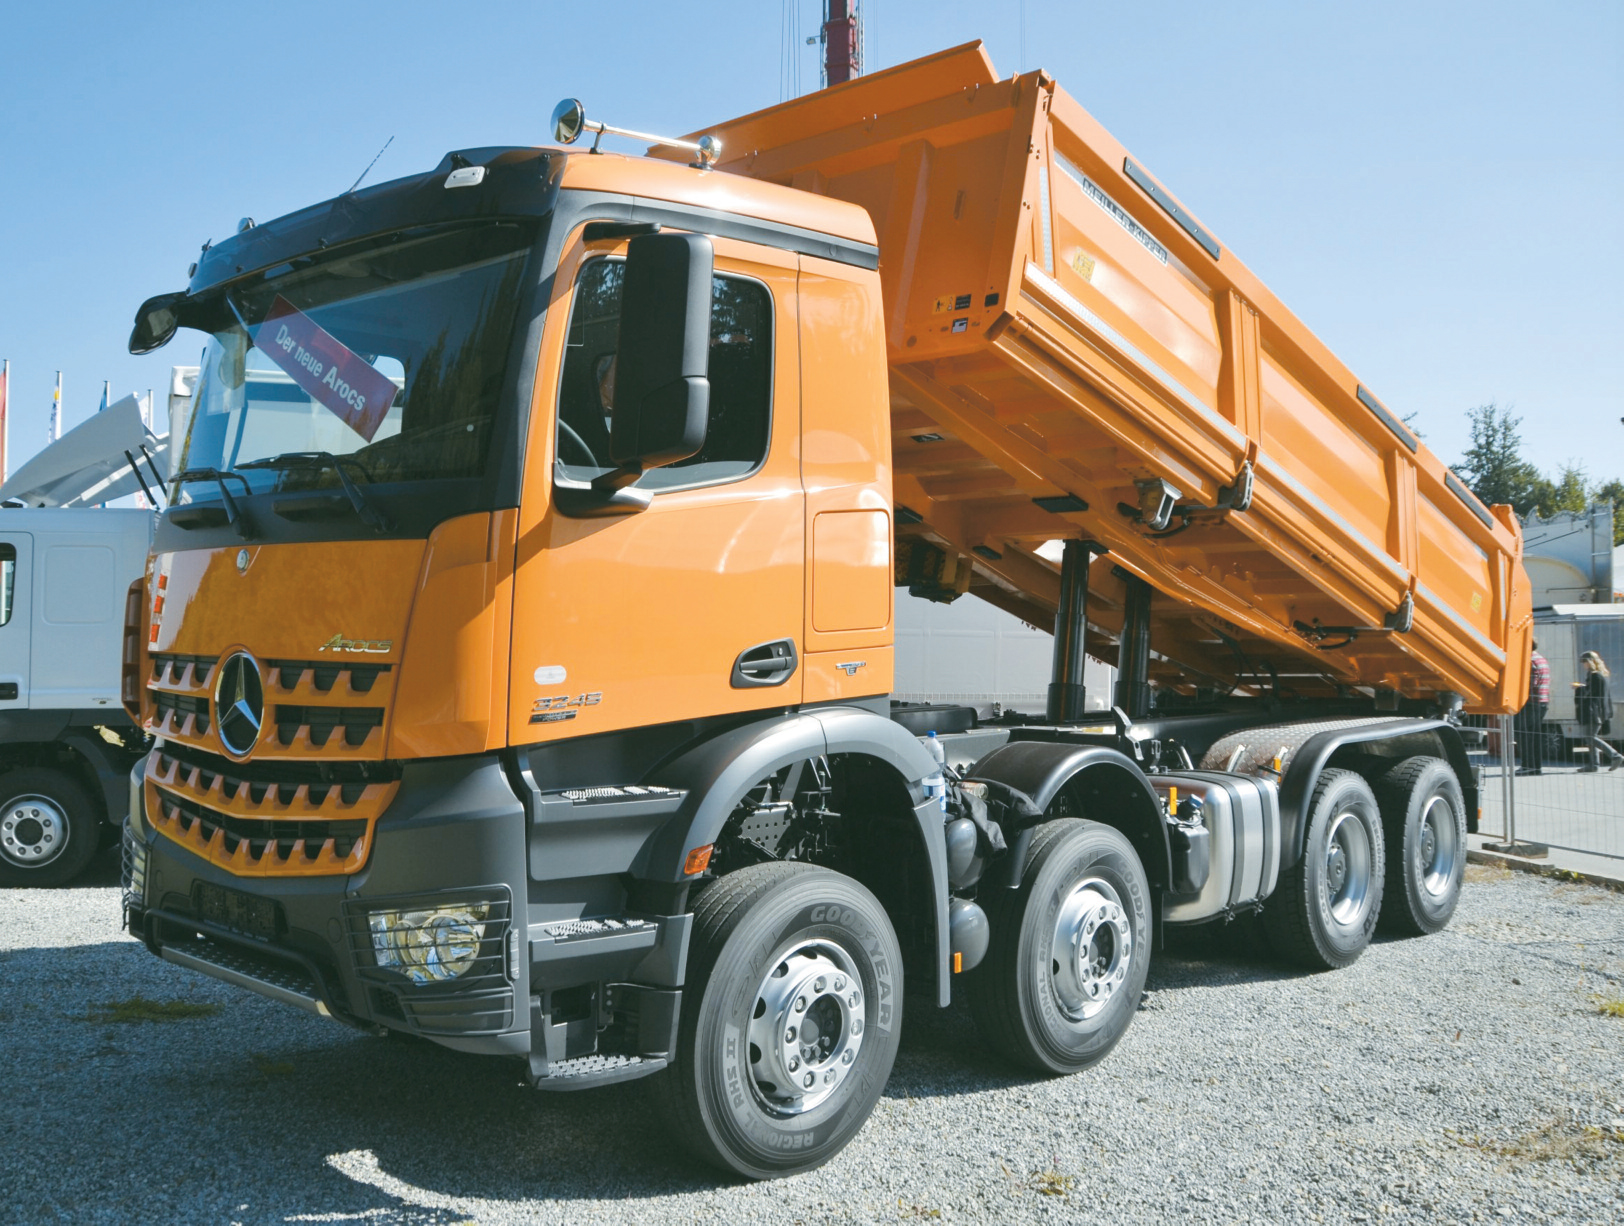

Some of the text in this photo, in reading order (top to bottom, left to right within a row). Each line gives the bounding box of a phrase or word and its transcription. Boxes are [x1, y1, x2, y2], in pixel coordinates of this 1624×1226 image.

[1083, 179, 1166, 263] MEILLER-KIPPER
[275, 324, 366, 411] Der neue Arocs
[532, 692, 603, 712] 3245
[810, 905, 893, 1028] GOODYEAR
[726, 1037, 737, 1059] II
[726, 1065, 745, 1110] RHS
